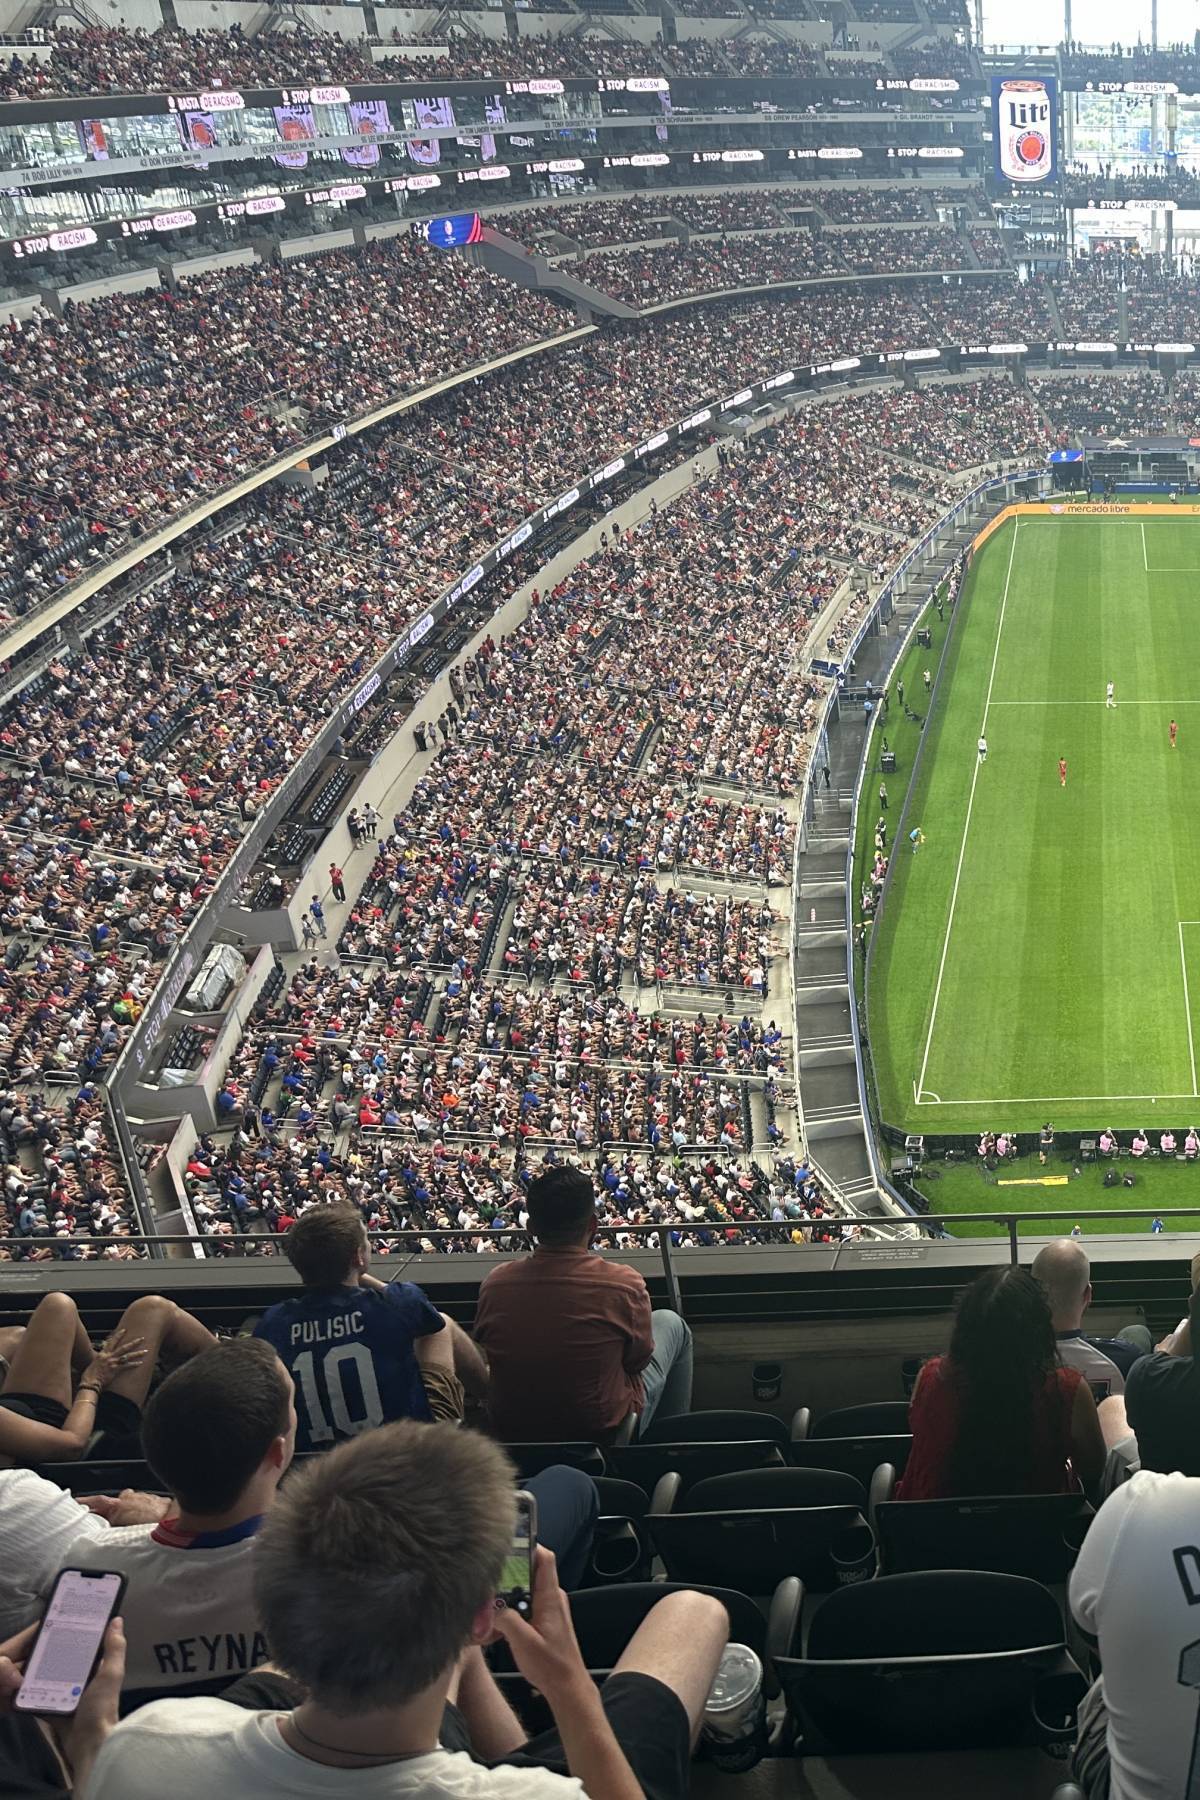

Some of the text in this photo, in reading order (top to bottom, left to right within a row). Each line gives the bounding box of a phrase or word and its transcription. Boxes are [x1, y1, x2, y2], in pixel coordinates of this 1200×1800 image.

[606, 80, 659, 90] STOP RACISM
[887, 80, 908, 88] BASTA
[1099, 82, 1166, 92] STOP RACISM
[292, 89, 341, 104] STOP RACISM
[179, 97, 199, 110] BASTA
[1008, 102, 1047, 129] Lite
[140, 159, 147, 167] 43
[149, 157, 161, 166] DON
[702, 153, 721, 161] STOP
[21, 173, 30, 183] 74
[32, 171, 46, 182] BOB
[46, 169, 62, 180] LILLY
[413, 176, 433, 188] RACISM
[226, 199, 277, 216] STOP RACISM
[1100, 201, 1122, 209] STOP
[131, 220, 153, 233] BASTA
[26, 231, 87, 254] STOP RACISM
[1056, 342, 1075, 350] STOP
[1068, 504, 1130, 513] mercado libre
[144, 1012, 161, 1051] STOP
[291, 1311, 364, 1345] PULISIC
[292, 1342, 384, 1442] 10
[153, 1631, 271, 1674] REYNA
